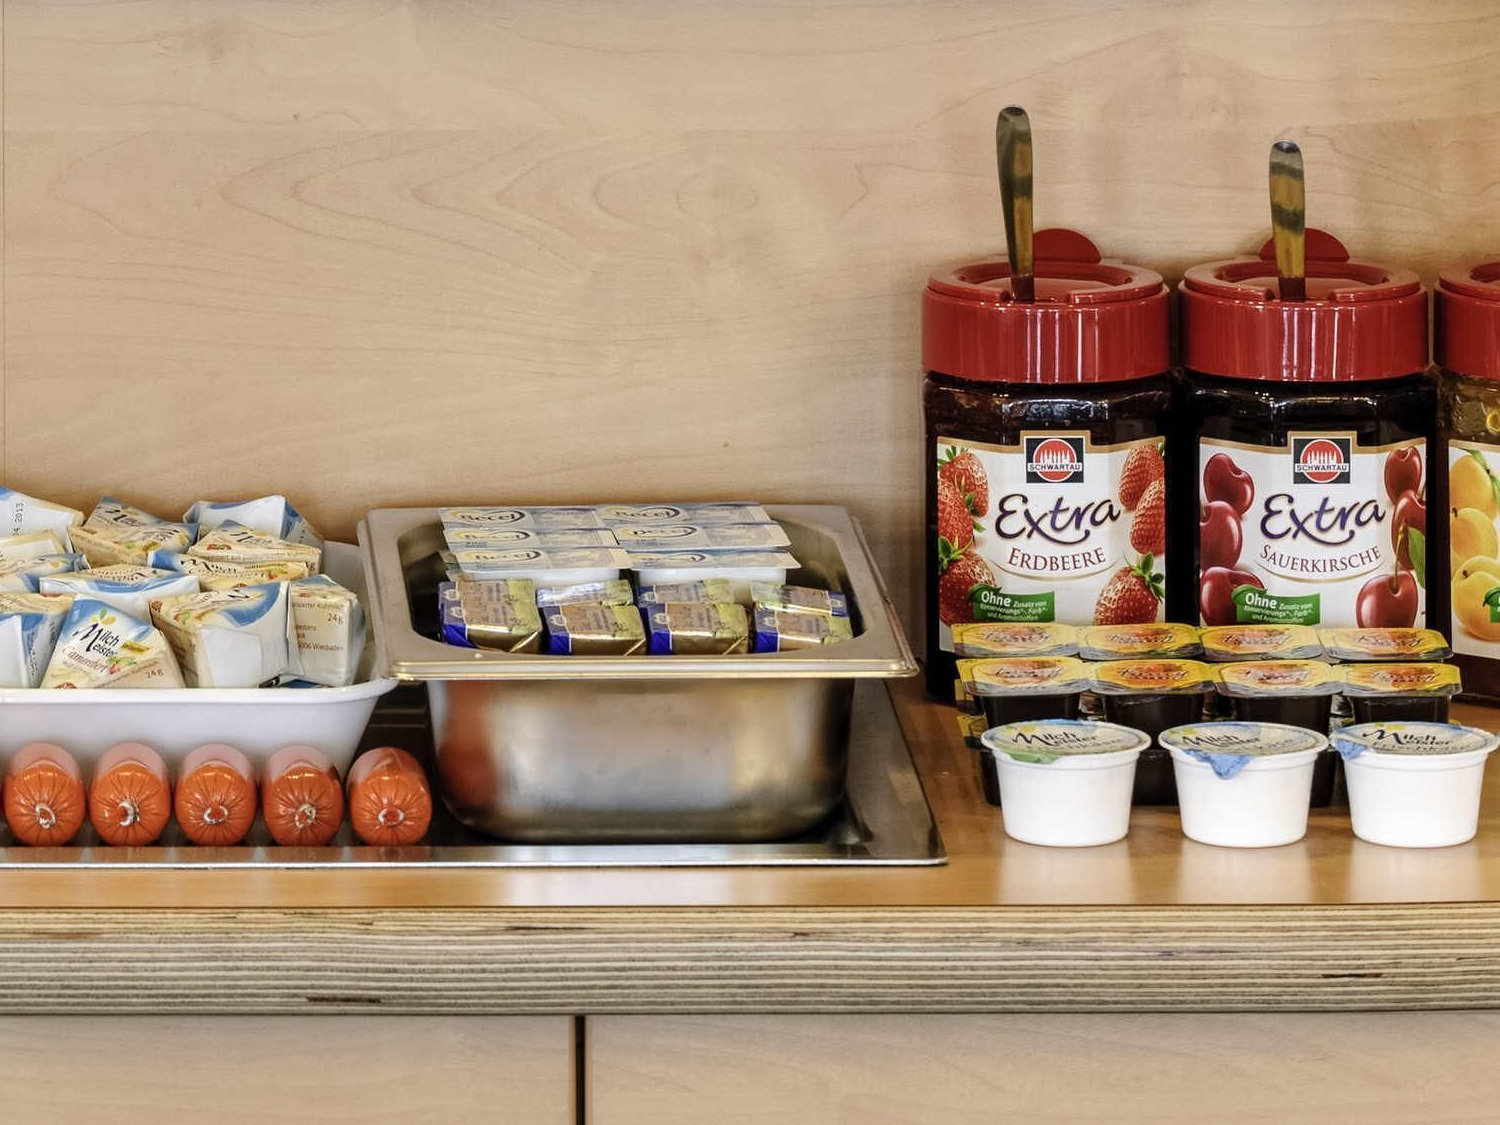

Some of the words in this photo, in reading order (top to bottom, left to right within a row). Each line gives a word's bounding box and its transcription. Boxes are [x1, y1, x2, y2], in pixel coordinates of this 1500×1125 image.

[1029, 463, 1081, 471] SCHWARTAU
[1296, 463, 1348, 472] SCHWARTAU
[995, 493, 1121, 546] Extra
[1260, 493, 1386, 546] Extra
[1008, 546, 1106, 571] ERDBEERE
[1260, 543, 1381, 573] SAUERKIRSCHE
[981, 590, 1012, 607] Ohne
[1245, 592, 1277, 609] Ohne
